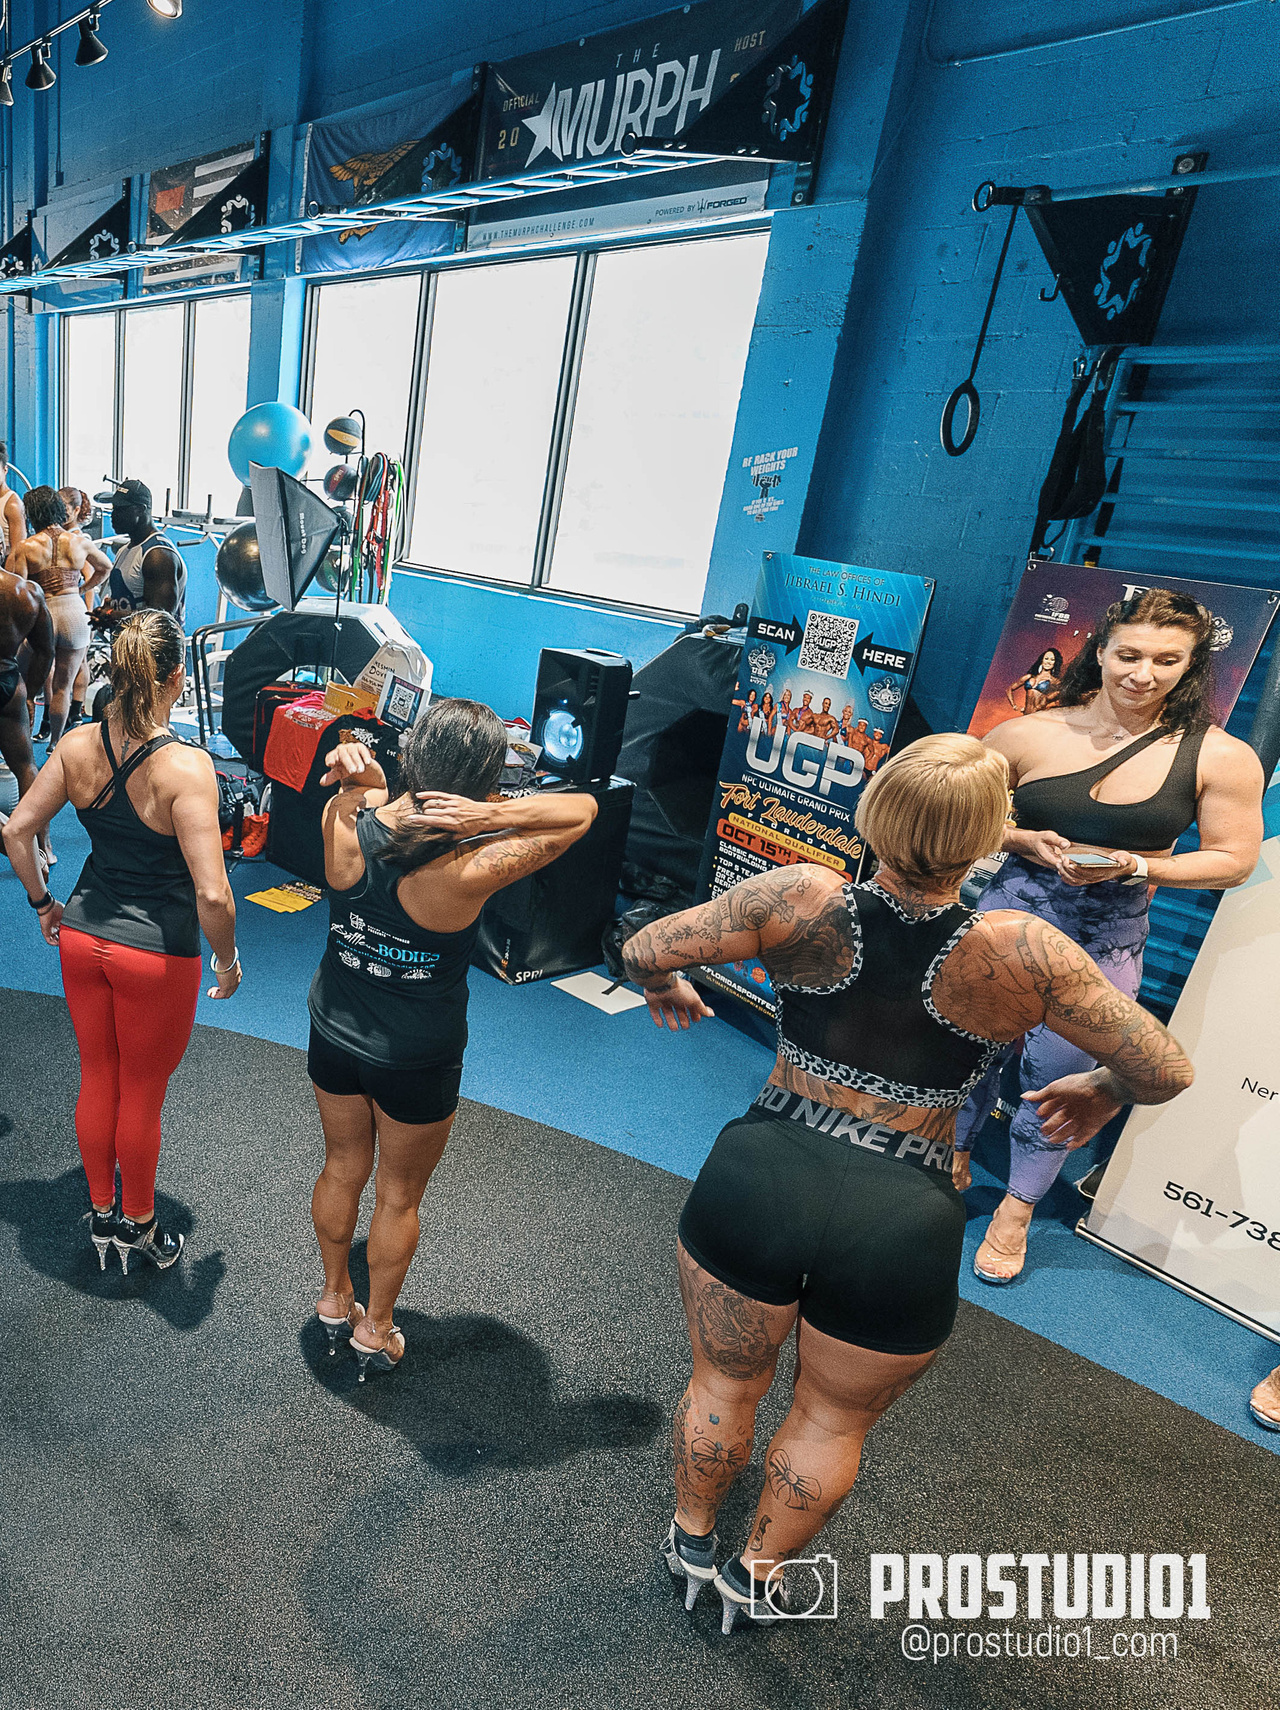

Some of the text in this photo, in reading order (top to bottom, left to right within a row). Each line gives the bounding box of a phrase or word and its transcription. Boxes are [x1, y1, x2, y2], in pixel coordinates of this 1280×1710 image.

[734, 31, 766, 52] HOST
[616, 43, 660, 68] THE
[502, 92, 541, 112] OFFICIAL
[551, 49, 721, 162] MURPH
[655, 196, 748, 217] POWERED BY FORGED
[482, 217, 595, 241] WWW.THEMURPHCHALLENGE.COM
[776, 446, 799, 460] YOUR
[750, 459, 786, 476] WEIGHTS
[809, 565, 886, 586] THE LAW OFFICES OF
[784, 572, 902, 607] JIBRAEL S. HINDI
[757, 622, 796, 642] SCAN
[819, 636, 838, 649] UGP
[862, 648, 907, 670] HERE
[745, 716, 866, 796] UGP
[741, 773, 851, 824] NPC ULTIMATE GRAND PRIX
[719, 780, 862, 861] Fort Lauderdale
[747, 811, 827, 851] FLORIDA
[722, 823, 756, 847] OCT
[731, 815, 782, 842] NATIONAL
[784, 835, 841, 867] QUALIFIER
[718, 846, 768, 872] BODYBUILDING
[719, 840, 768, 867] CLASSIC PHYS
[719, 857, 734, 868] TOP
[734, 864, 740, 872] 5
[715, 871, 726, 880] OR
[716, 865, 735, 879] FREE
[377, 943, 440, 963] BODIES
[515, 968, 544, 983] SPRI
[754, 1082, 792, 1113] RO
[789, 1097, 897, 1154] NIKE
